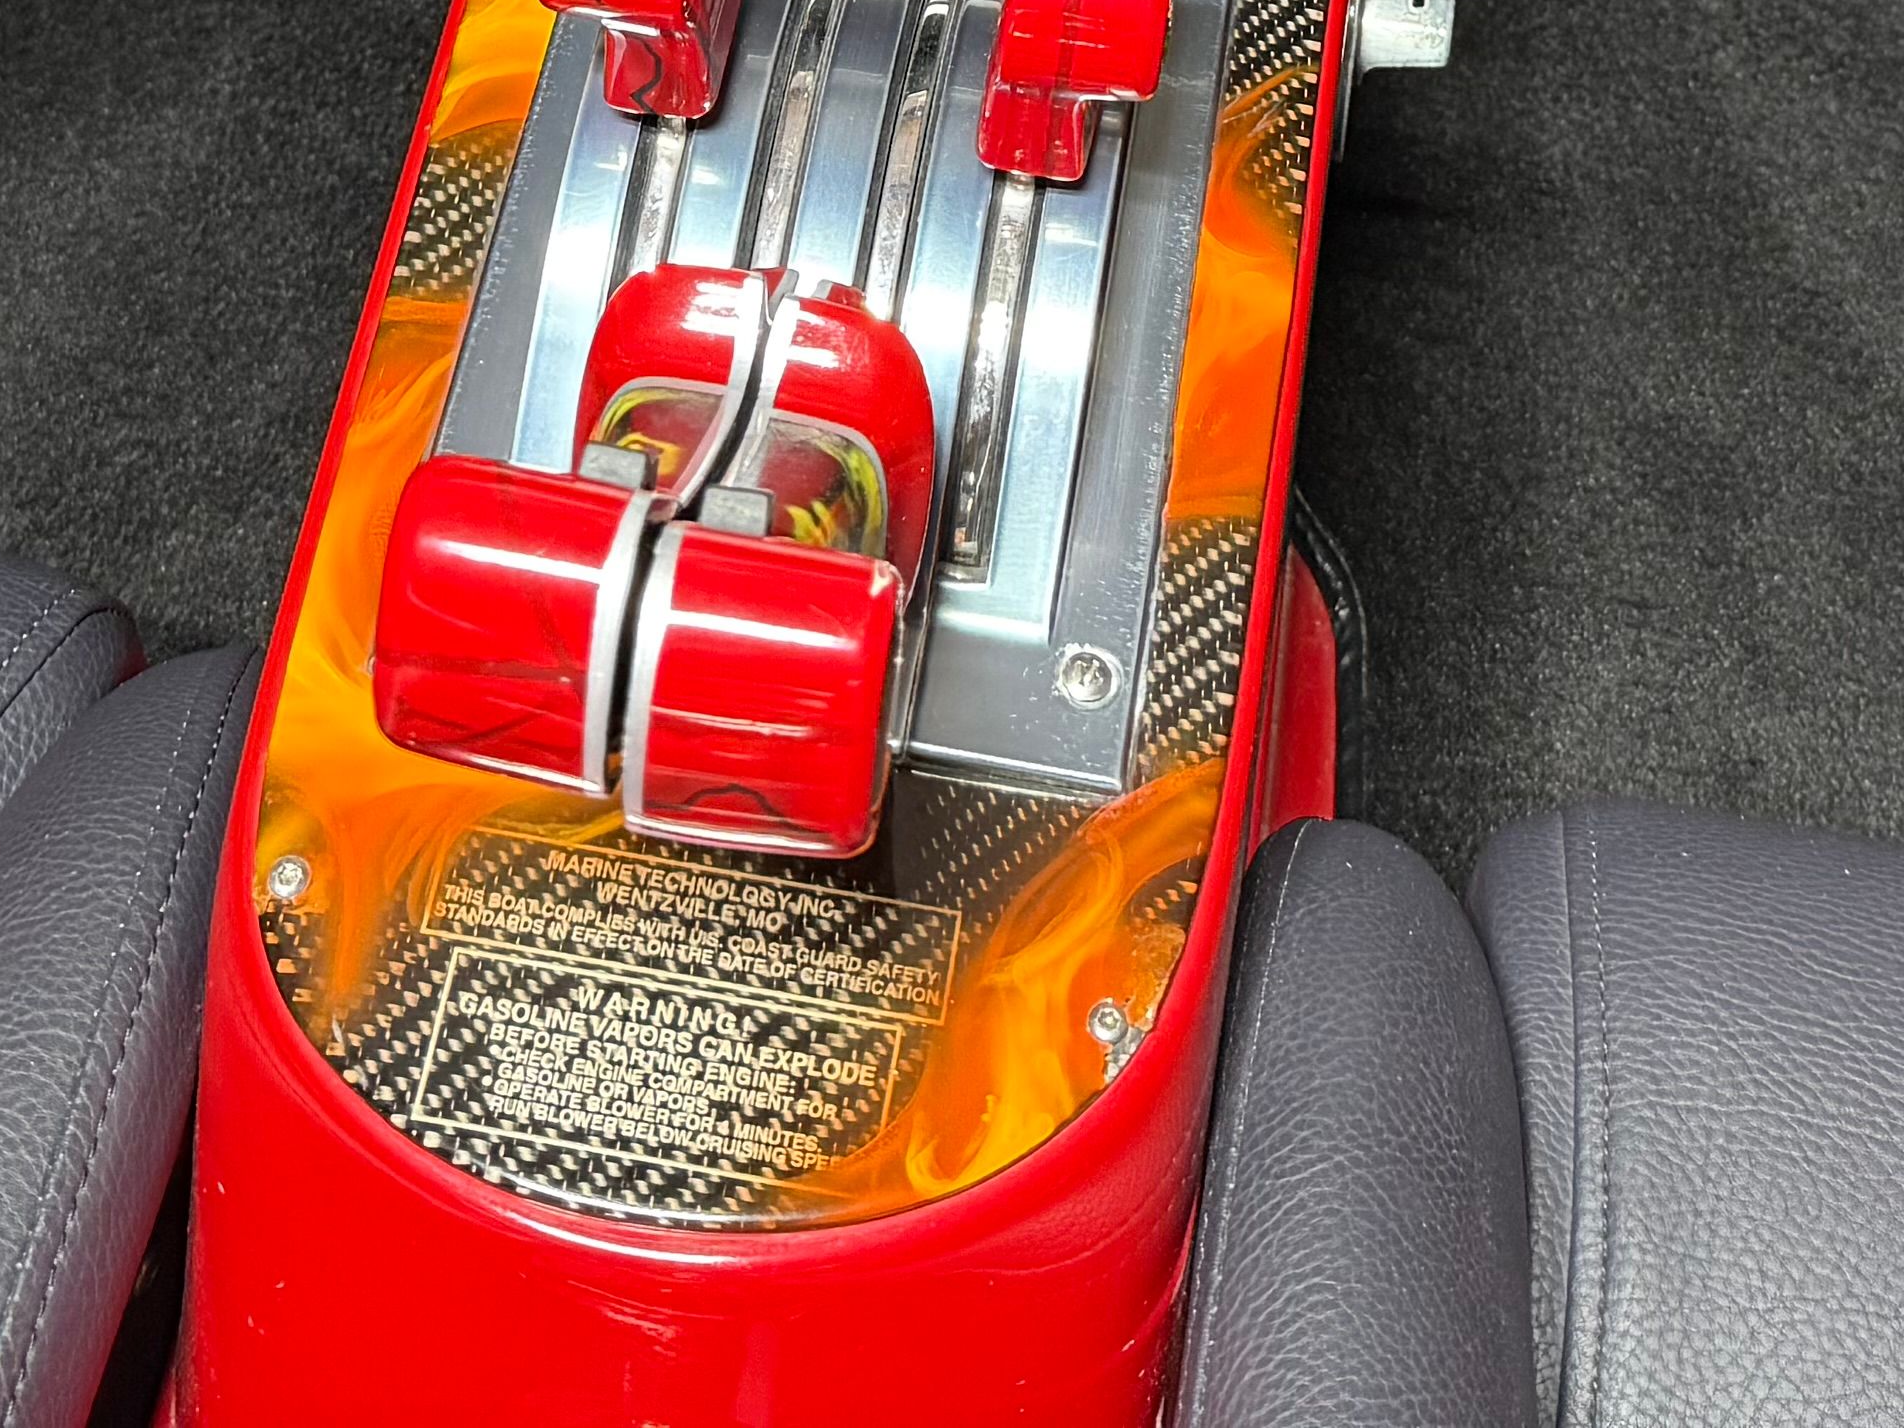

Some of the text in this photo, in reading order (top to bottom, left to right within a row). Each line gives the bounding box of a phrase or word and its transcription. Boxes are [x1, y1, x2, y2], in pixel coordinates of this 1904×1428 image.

[546, 849, 634, 885] MARINE
[433, 901, 940, 1006] STANDARDS IN EFFECT ON THE DATE OF CERTIFICATION
[444, 884, 484, 906] THIS
[488, 892, 535, 913] BOAT
[541, 903, 635, 932] COMPLIES
[640, 917, 685, 940] WITH
[728, 935, 792, 959] COAST
[796, 949, 862, 973] GUARD
[866, 959, 941, 985] SAFETY
[747, 910, 783, 932] MO
[458, 990, 877, 1087] GASOLINE VAPORS CAN EXPLODE
[489, 1022, 796, 1094] BEFORE STARTING ENGINE:
[493, 1080, 582, 1109] OPERATE
[586, 1095, 669, 1125] BLOWER
[673, 1113, 713, 1133] FOR
[497, 1062, 595, 1094] GASOLINE
[599, 1080, 628, 1099] OR
[502, 1046, 838, 1120] CHECK ENGINE COMPARTMENT FOR
[492, 1096, 530, 1118] RUN
[534, 1102, 618, 1133] BLOWER
[621, 1119, 690, 1148] BELOW
[694, 1133, 786, 1166] CRUISING
